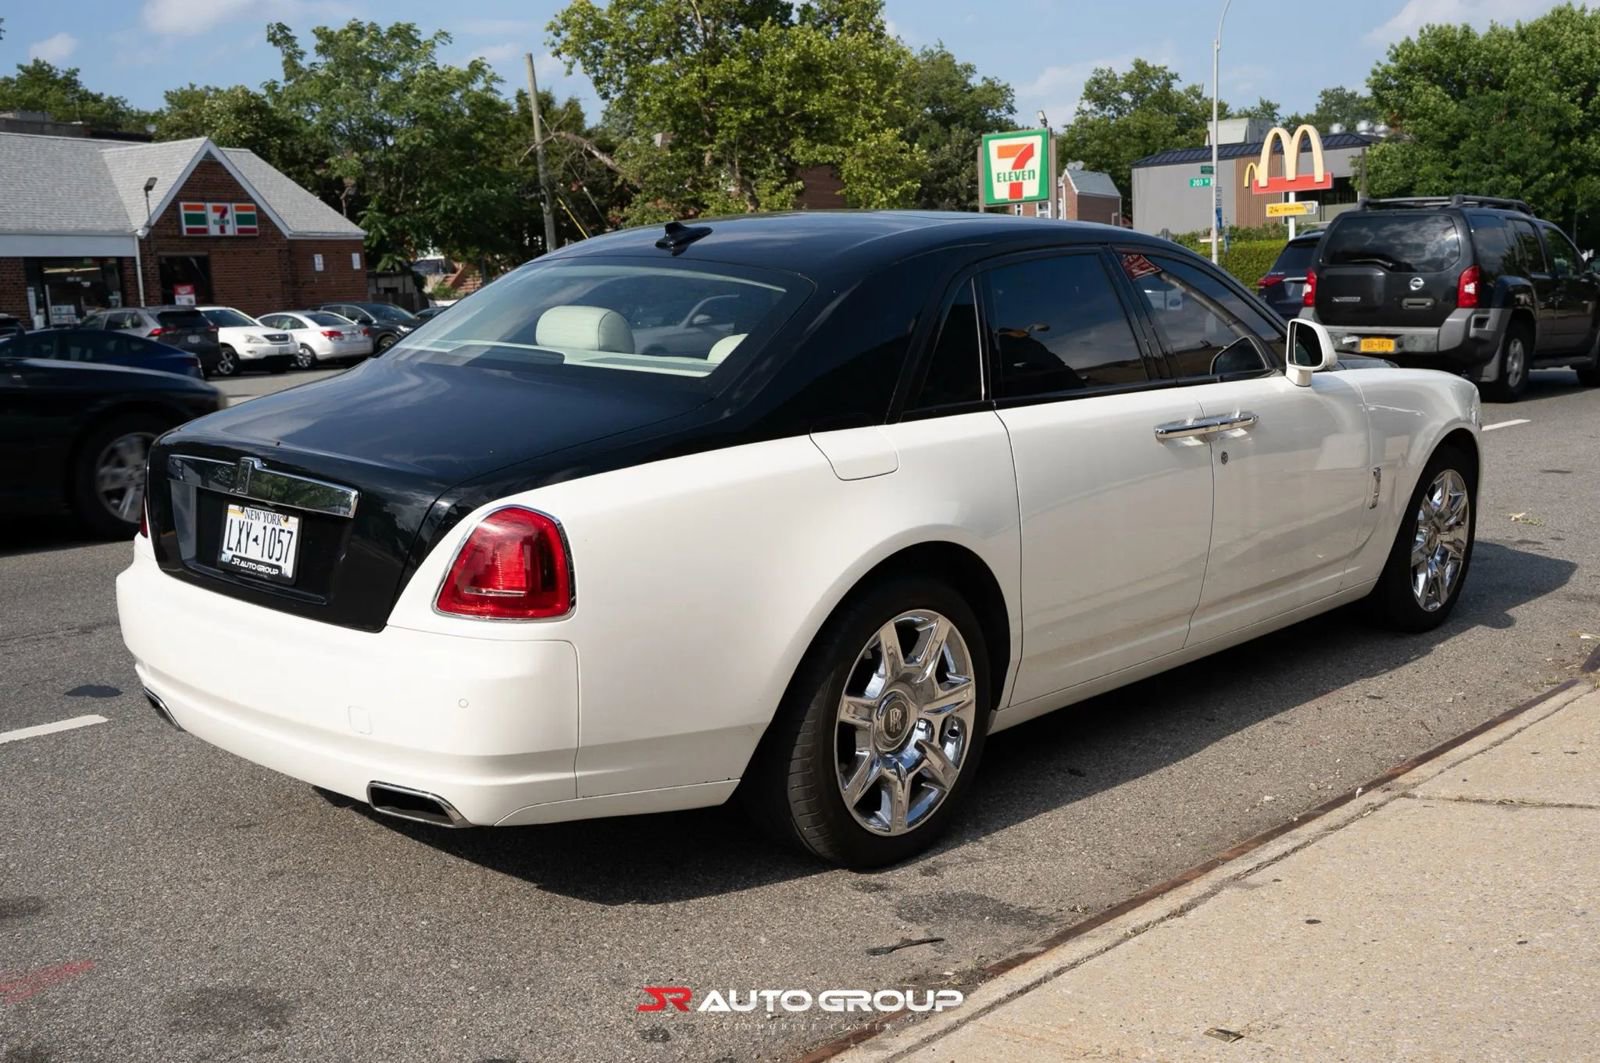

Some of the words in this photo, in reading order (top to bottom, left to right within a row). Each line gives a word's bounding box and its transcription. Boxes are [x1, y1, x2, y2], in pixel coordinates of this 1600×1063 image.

[997, 143, 1034, 200] 7
[212, 205, 228, 235] 7
[245, 508, 261, 521] NEW
[263, 511, 283, 527] YORK
[226, 518, 253, 554] LXY
[261, 525, 294, 564] 1057
[240, 560, 257, 571] AUTO
[256, 564, 279, 575] GROUP
